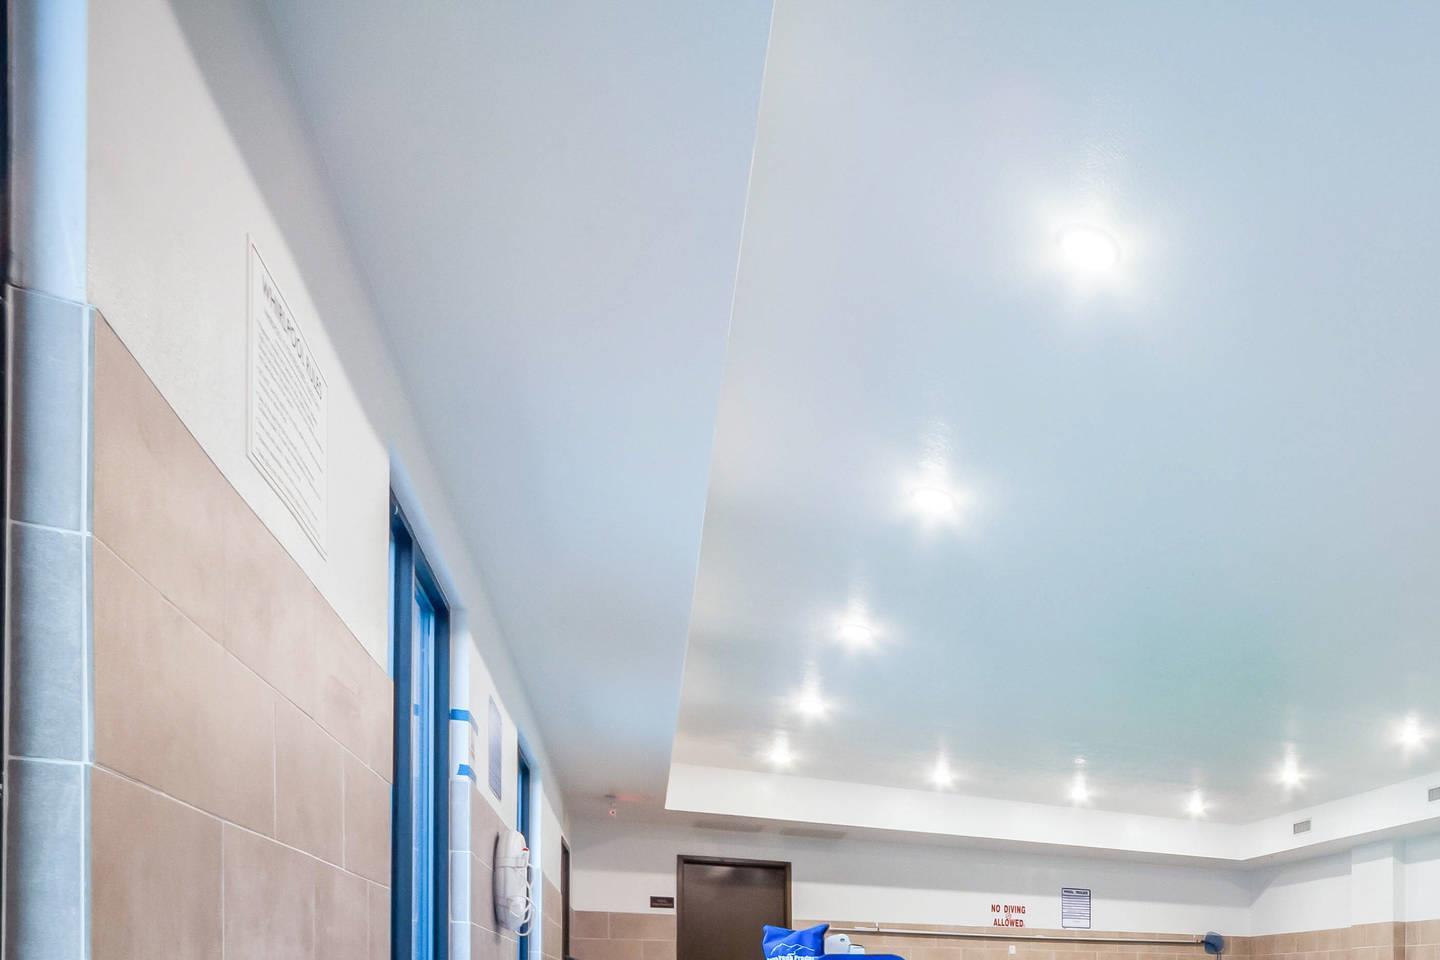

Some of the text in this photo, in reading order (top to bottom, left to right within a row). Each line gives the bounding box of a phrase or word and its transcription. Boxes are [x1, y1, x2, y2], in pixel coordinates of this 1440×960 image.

[991, 904, 1026, 914] NO DIVING
[993, 918, 1024, 927] ALLOWED
